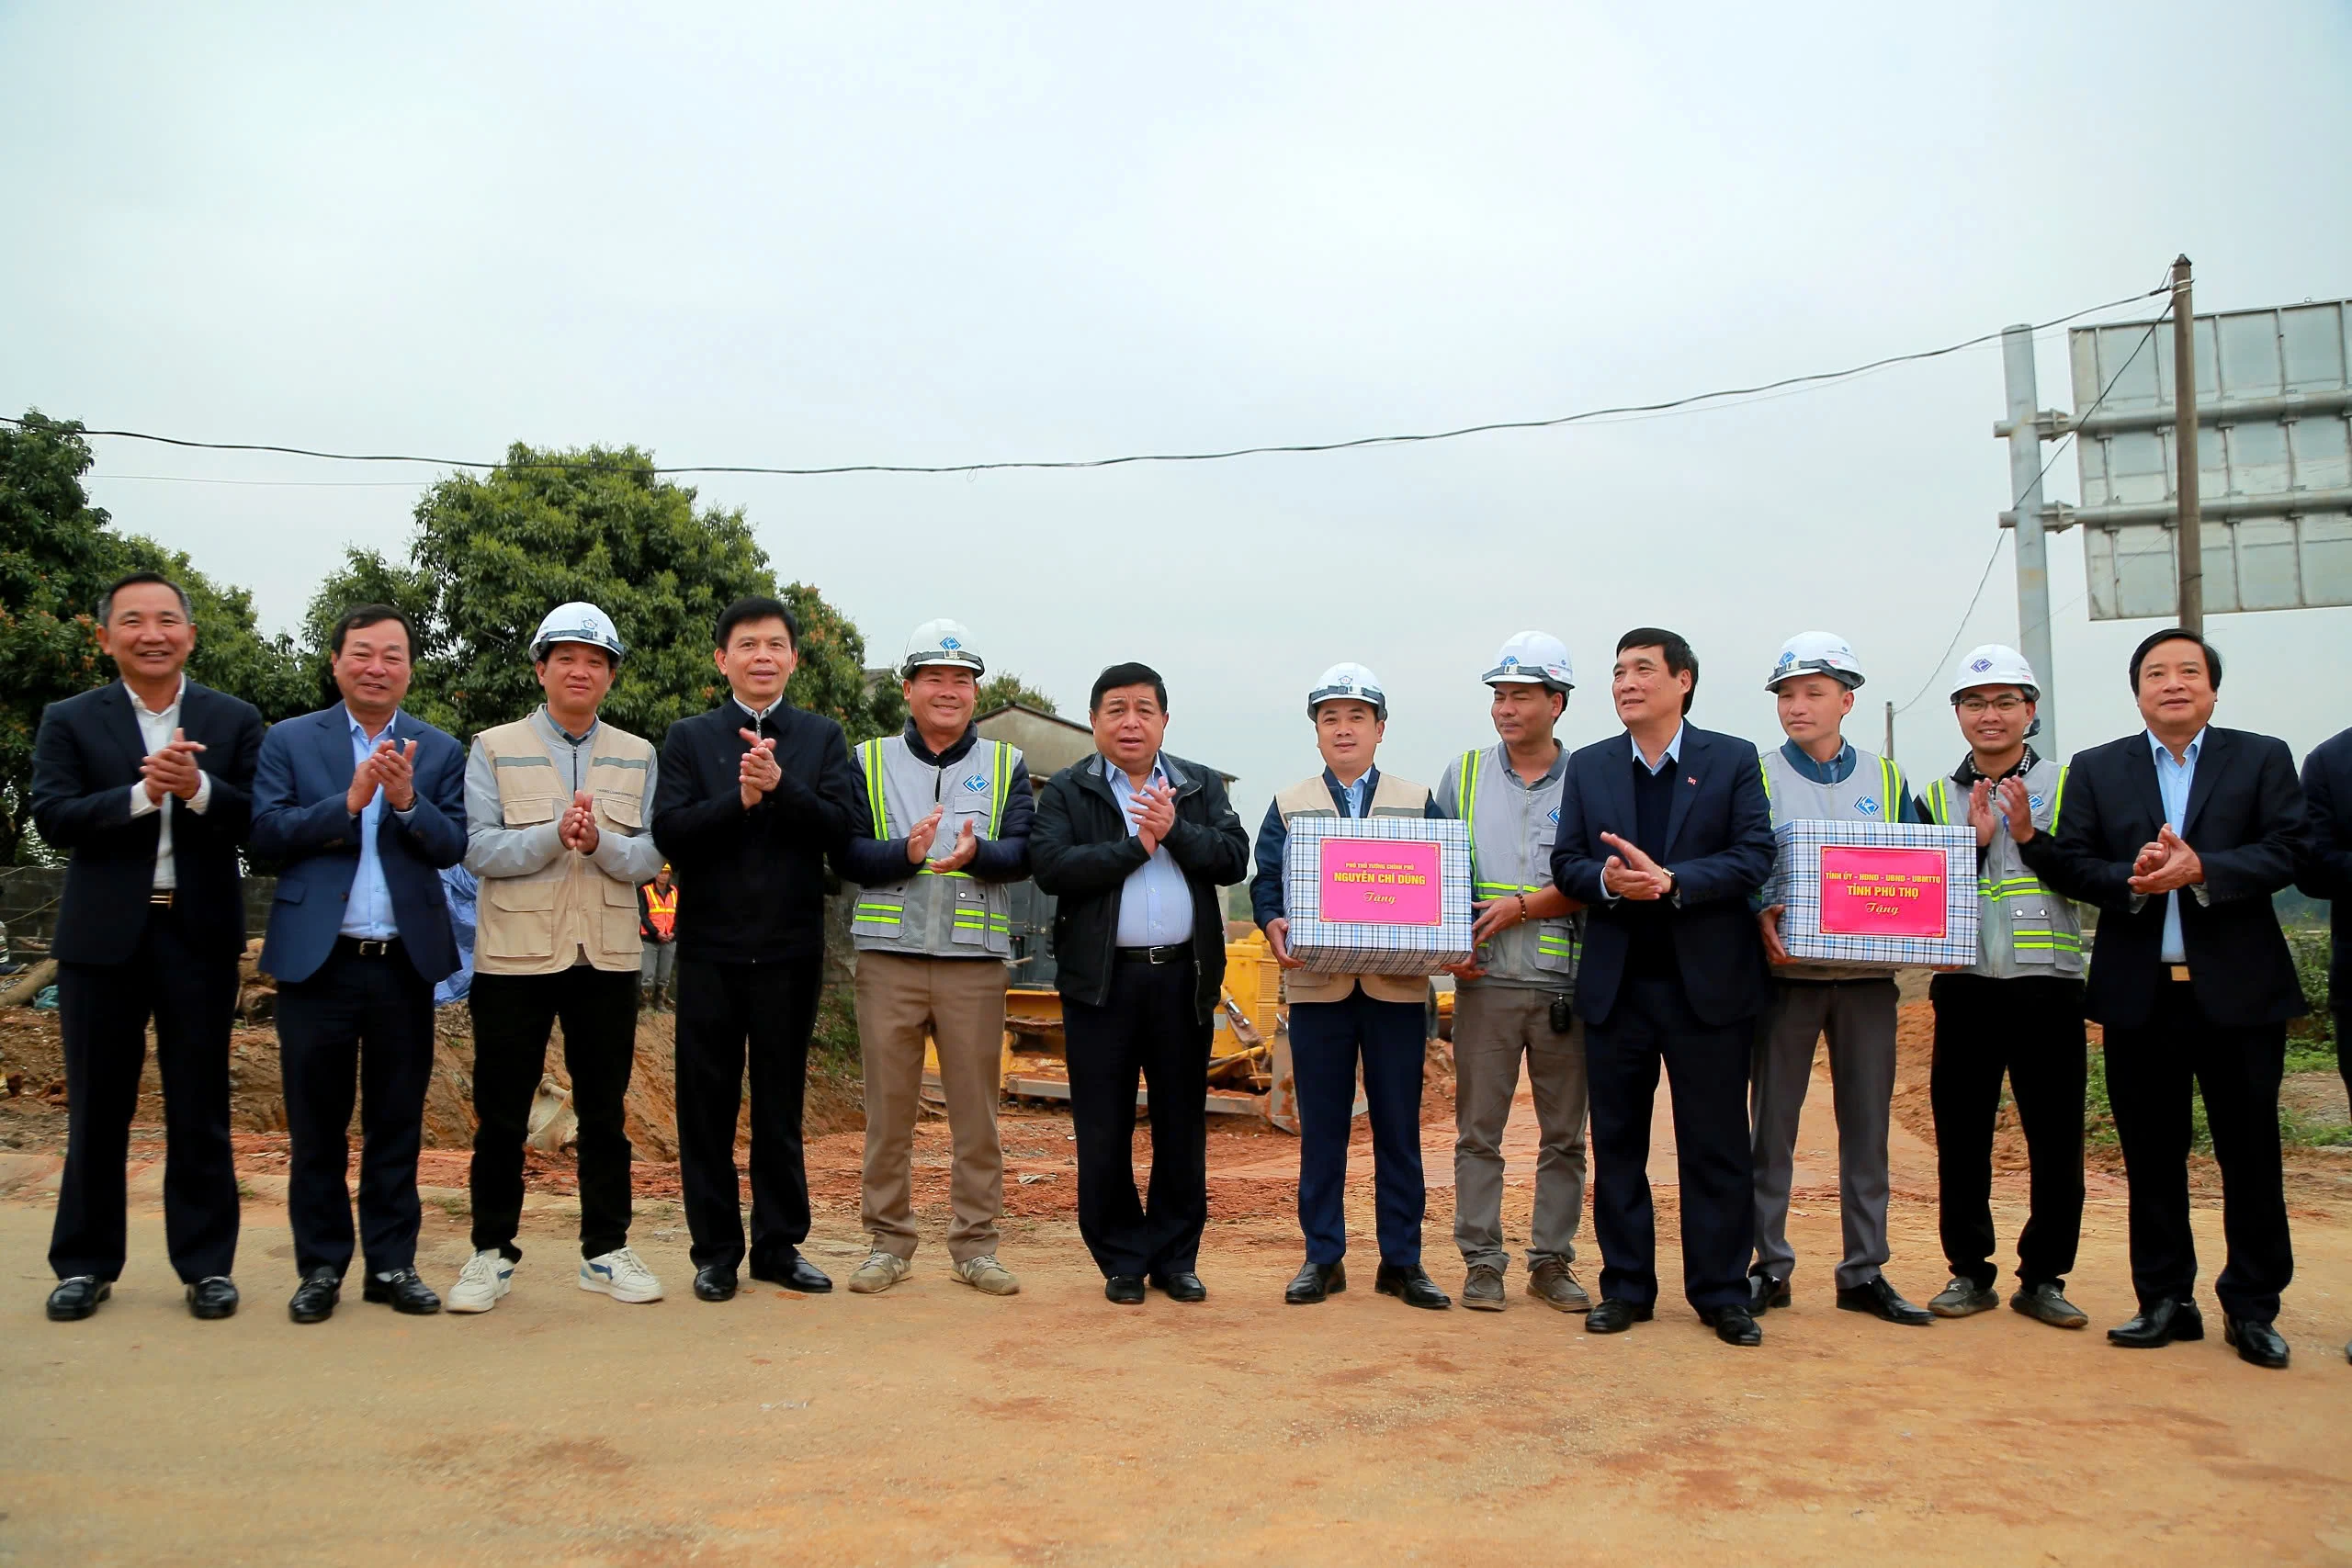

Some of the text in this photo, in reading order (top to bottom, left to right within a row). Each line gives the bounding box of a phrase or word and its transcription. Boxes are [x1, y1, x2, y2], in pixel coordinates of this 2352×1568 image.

[1334, 870, 1426, 885] NGUYỄN CHÍ DŨNG
[1364, 891, 1396, 905] Tặng
[1847, 883, 1919, 899] TỈNH PHÚ THỌ
[1866, 902, 1900, 916] Tặng
